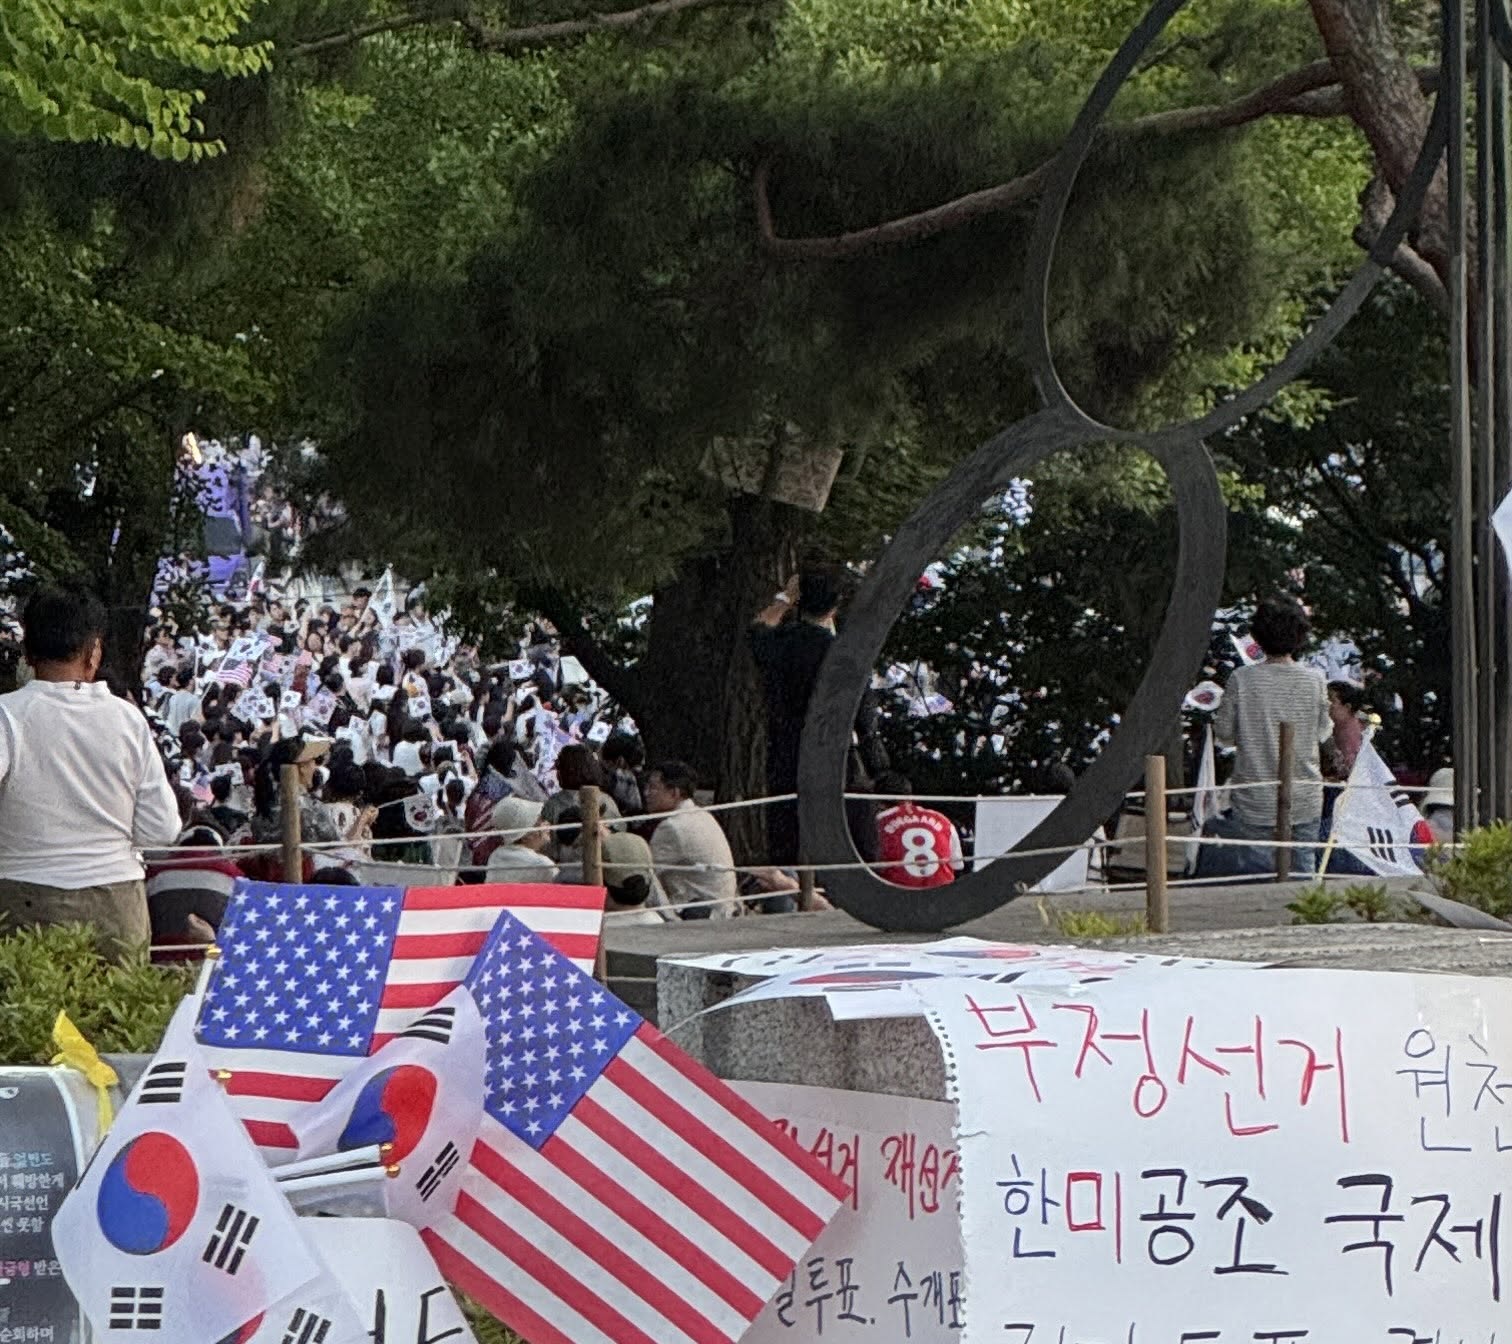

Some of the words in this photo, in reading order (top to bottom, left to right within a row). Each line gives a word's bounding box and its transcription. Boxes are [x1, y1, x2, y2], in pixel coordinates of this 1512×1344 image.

[901, 827, 940, 879] 8
[964, 993, 1349, 1144] 부정선거
[995, 1153, 1289, 1275] 한미공조
